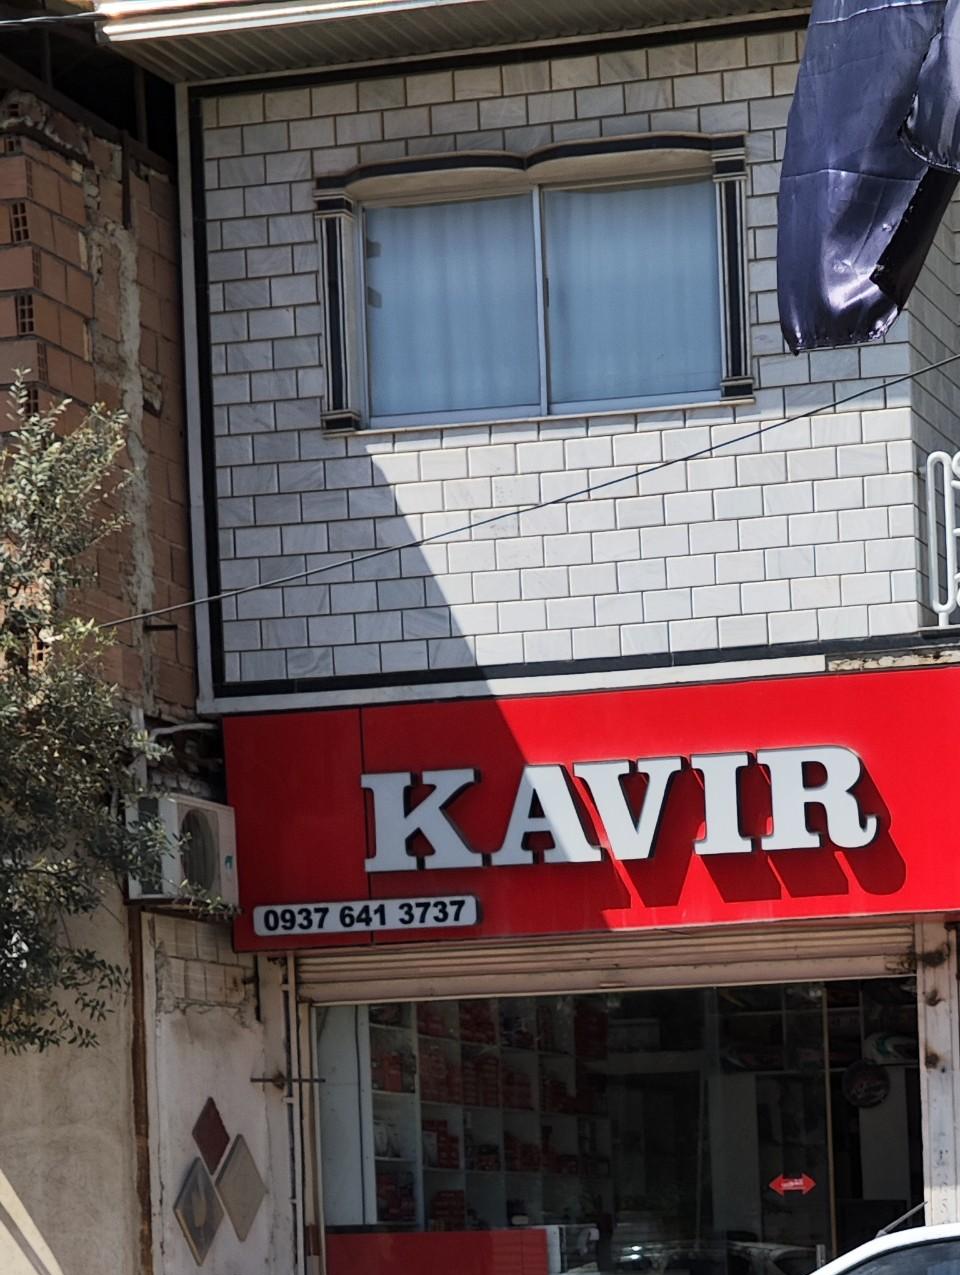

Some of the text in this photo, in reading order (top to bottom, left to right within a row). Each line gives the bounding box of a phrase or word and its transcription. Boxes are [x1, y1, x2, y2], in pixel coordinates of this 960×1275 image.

[361, 745, 877, 872] KAVIR
[263, 900, 465, 931] 0937 641 3737
